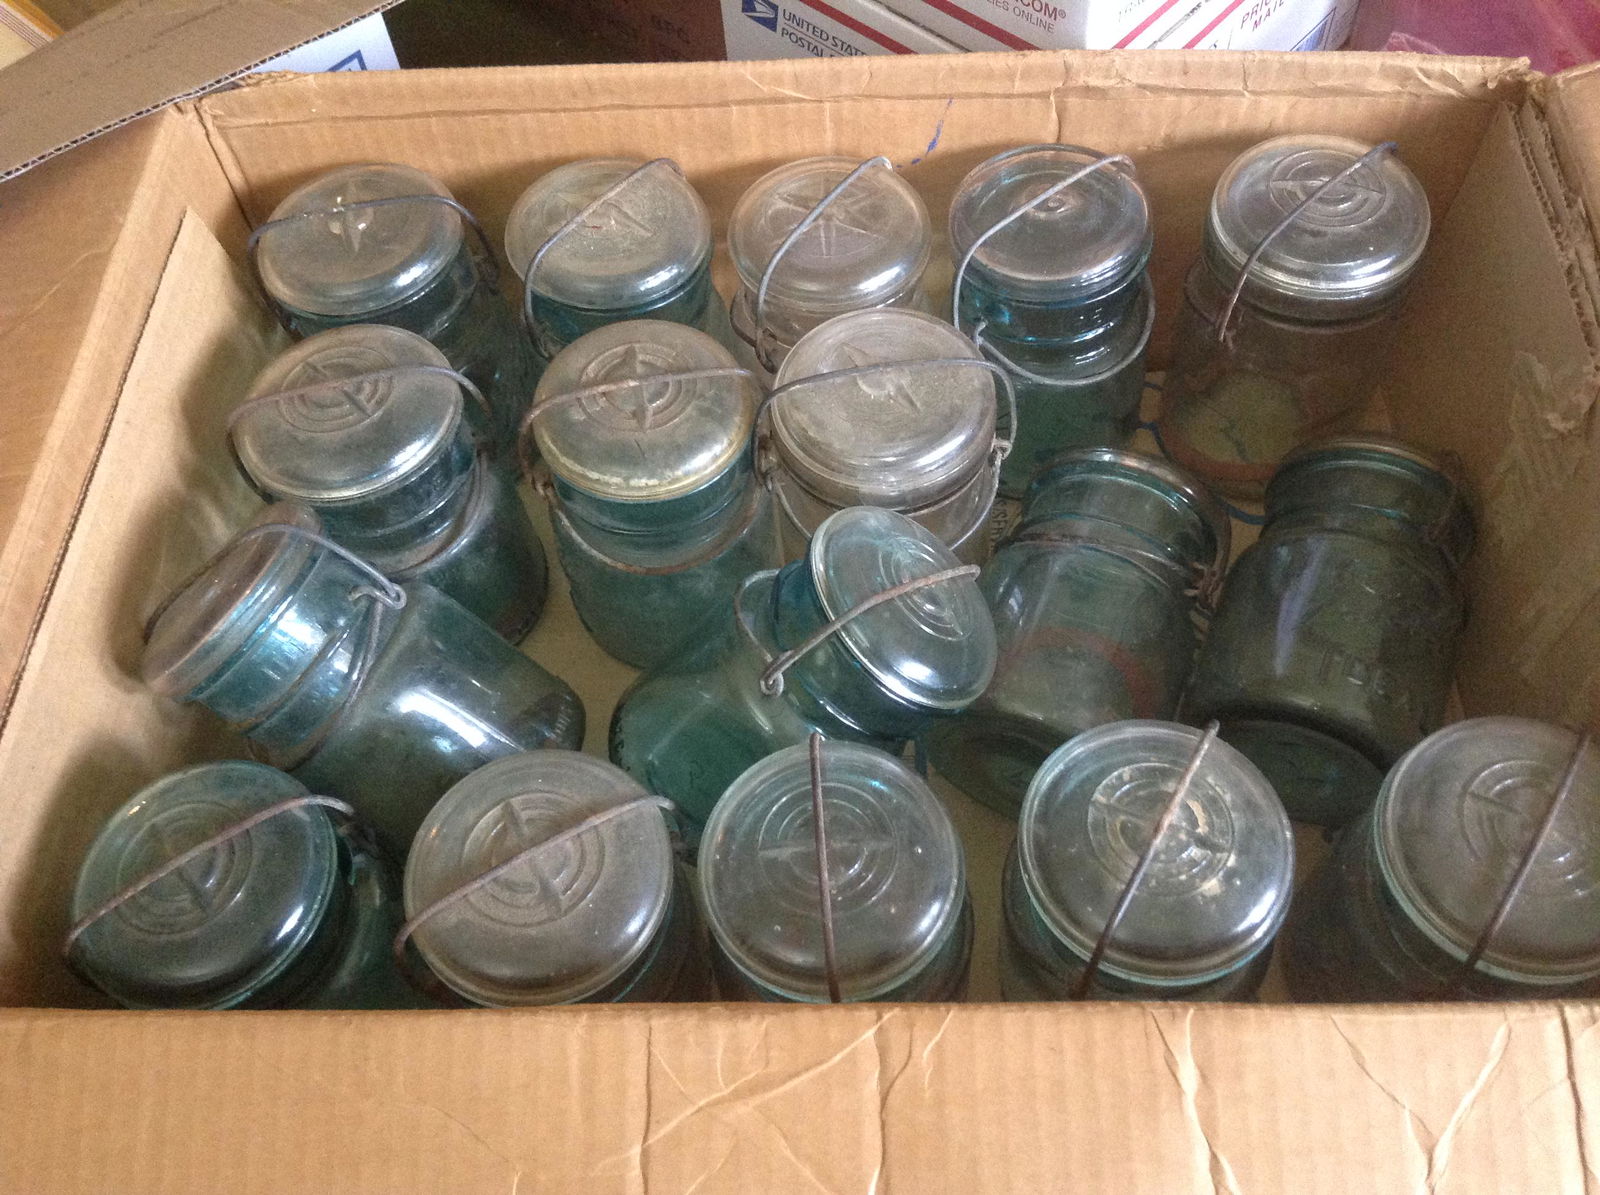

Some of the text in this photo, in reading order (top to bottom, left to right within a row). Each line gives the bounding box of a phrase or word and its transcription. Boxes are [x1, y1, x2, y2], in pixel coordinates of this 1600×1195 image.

[783, 8, 867, 56] UNITED STAT
[1013, 6, 1055, 33] ONLINE
